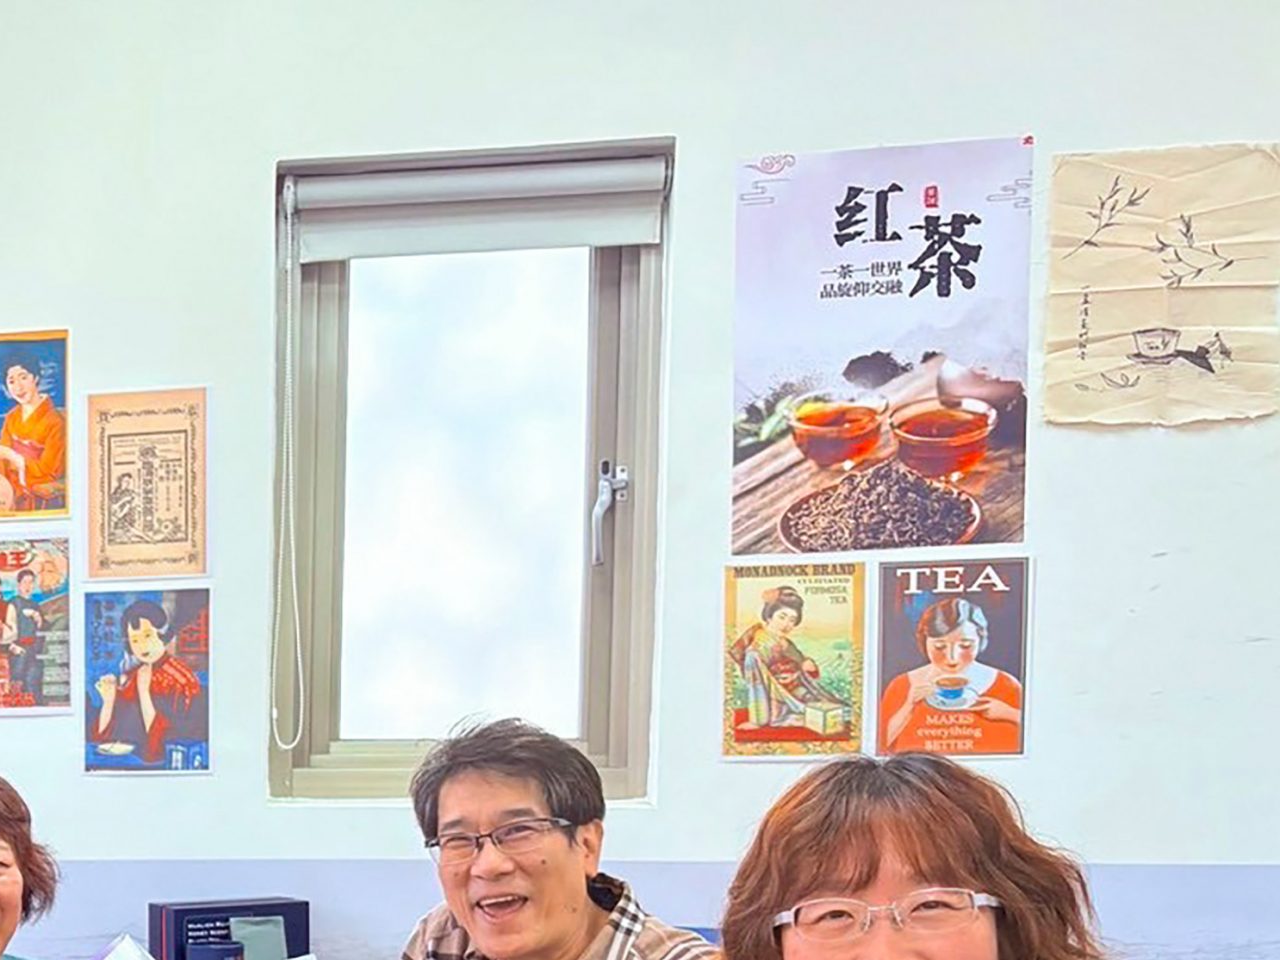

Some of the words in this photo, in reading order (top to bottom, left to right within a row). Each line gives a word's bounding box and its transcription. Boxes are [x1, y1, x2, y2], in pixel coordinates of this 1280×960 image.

[821, 261, 903, 280] 一茶一世界
[734, 564, 809, 578] MONADNOCK
[812, 562, 856, 576] BRAND
[896, 564, 1010, 595] TEA
[828, 596, 848, 605] TEA
[926, 713, 974, 725] MAKES
[916, 726, 983, 739] everything
[924, 739, 974, 752] BETTER
